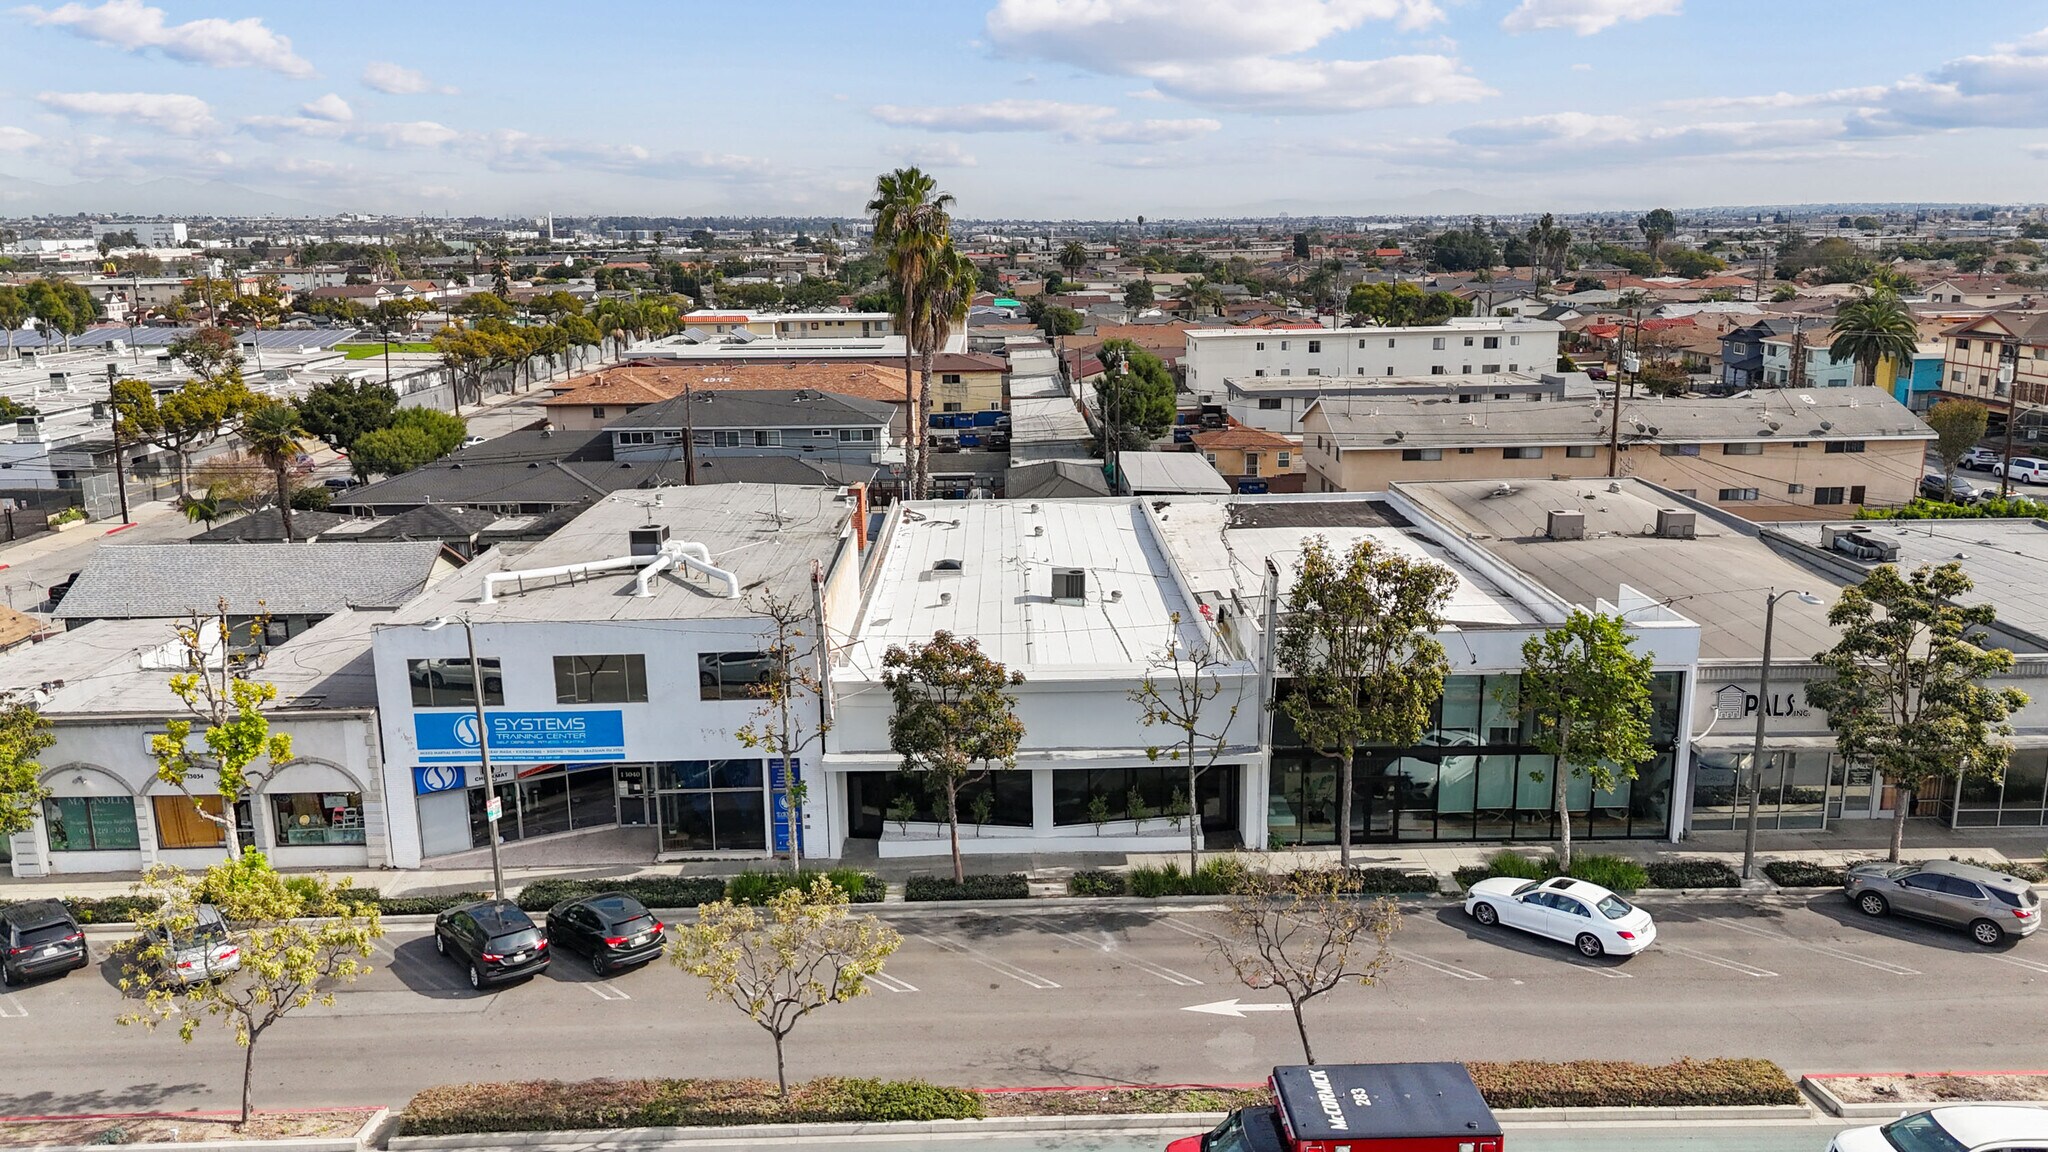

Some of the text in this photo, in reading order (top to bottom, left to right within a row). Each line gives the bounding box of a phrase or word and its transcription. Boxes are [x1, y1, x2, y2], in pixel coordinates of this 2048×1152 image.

[494, 717, 586, 731] SYSTEMS
[474, 772, 508, 782] CHKMAT
[1308, 1069, 1349, 1130] McCORMICK
[1350, 1088, 1372, 1106] 283
